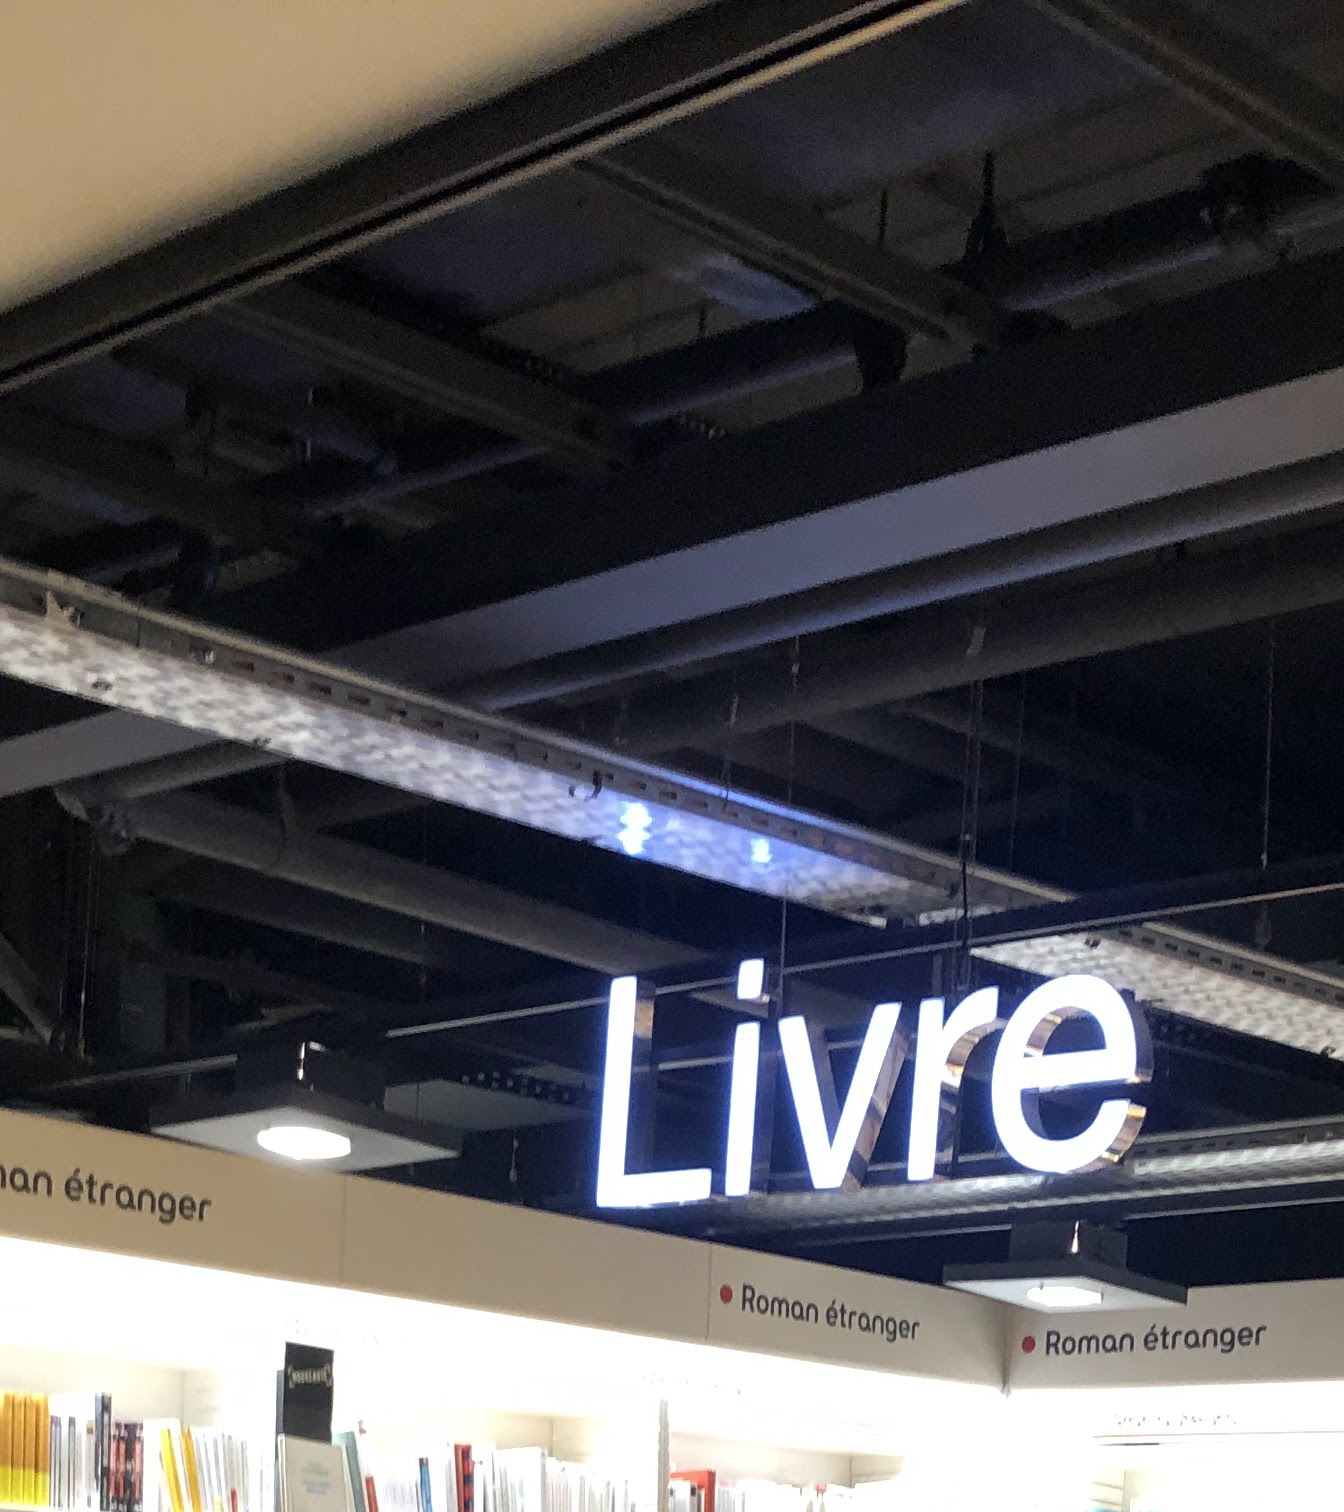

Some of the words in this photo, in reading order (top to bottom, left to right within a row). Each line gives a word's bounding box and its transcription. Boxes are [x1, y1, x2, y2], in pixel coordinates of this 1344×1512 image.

[596, 957, 1138, 1208] Livre
[63, 1167, 213, 1225] étranger
[741, 1283, 819, 1325] Roman
[825, 1298, 921, 1344] étranger
[1044, 1328, 1135, 1357] Roman
[1142, 1322, 1268, 1356] étranger
